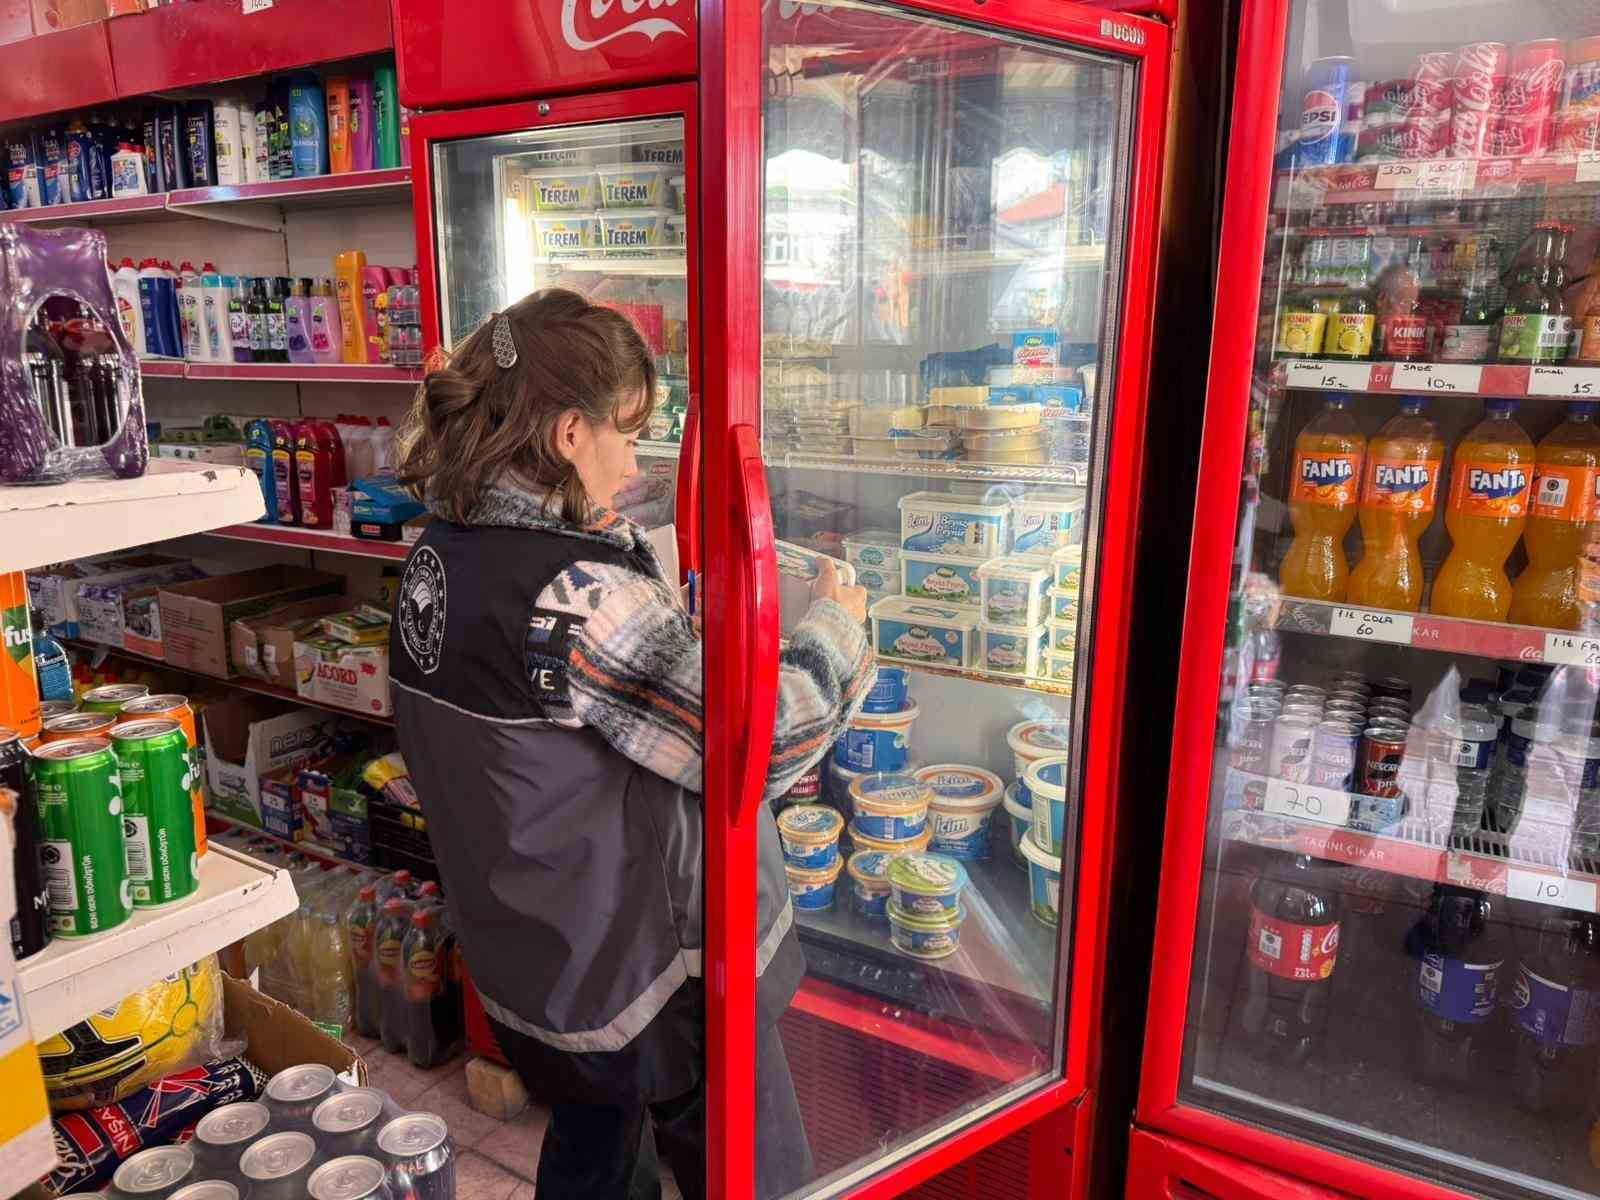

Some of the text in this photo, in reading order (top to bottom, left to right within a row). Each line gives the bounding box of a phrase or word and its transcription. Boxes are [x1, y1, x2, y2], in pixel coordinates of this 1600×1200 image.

[1303, 110, 1337, 124] EPSI
[540, 187, 580, 205] TEREM
[606, 184, 648, 202] TEREM
[542, 230, 580, 247] TEREM
[607, 228, 647, 246] TEREM
[1302, 458, 1353, 478] FANTA
[1375, 464, 1429, 486] FANTA
[1470, 469, 1526, 490] FANTA
[1356, 623, 1375, 636] 60
[1284, 786, 1322, 815] 70
[1536, 880, 1561, 898] 10
